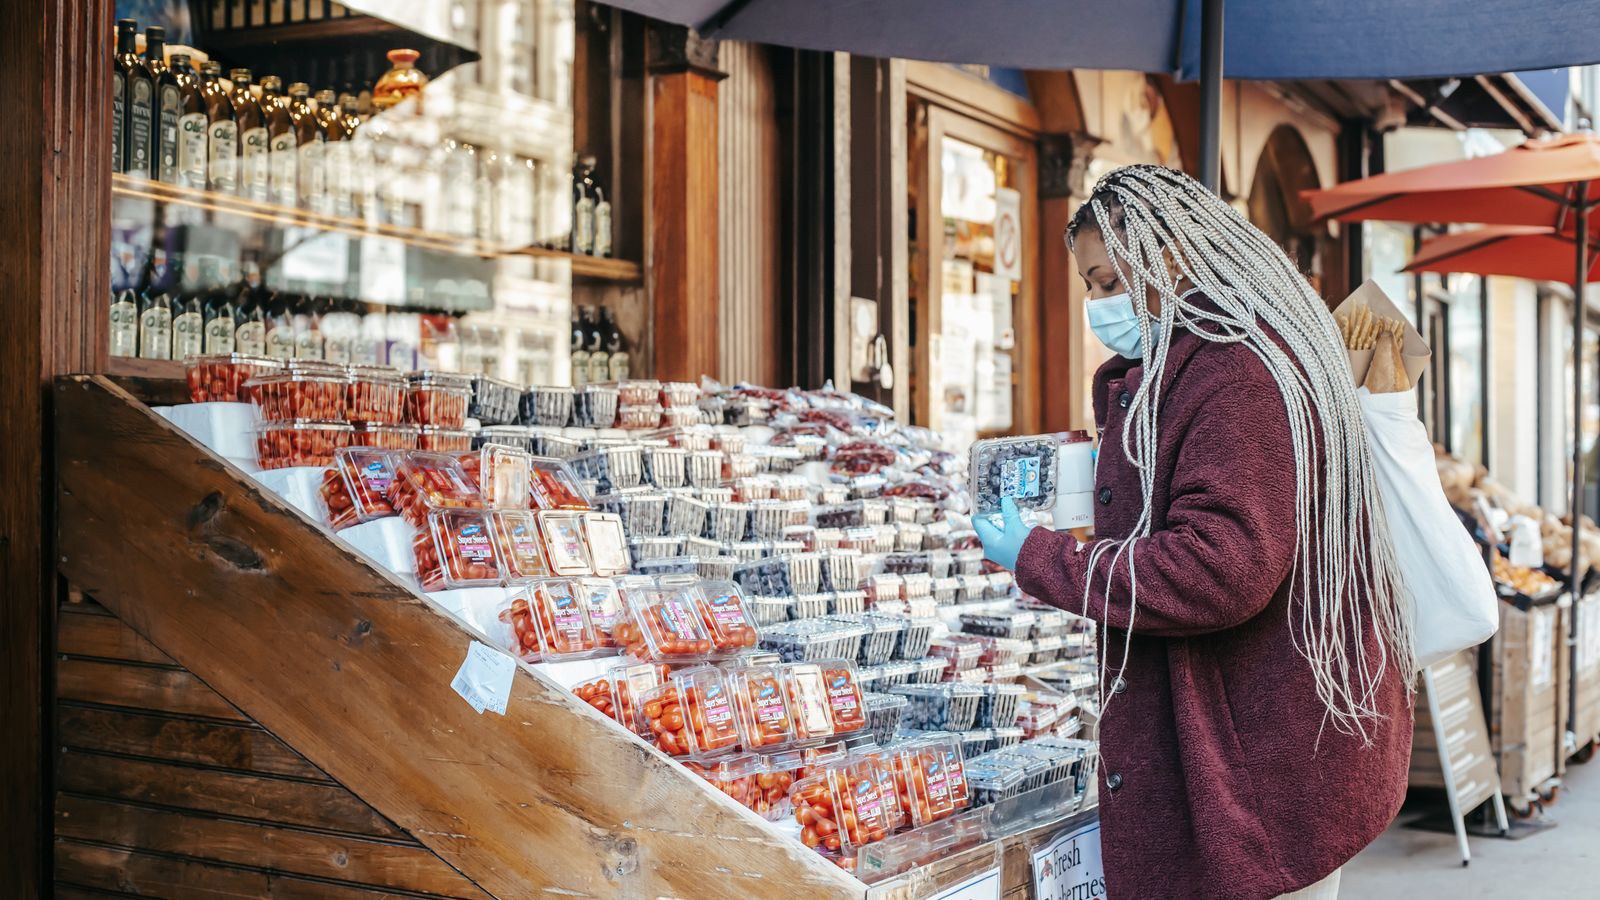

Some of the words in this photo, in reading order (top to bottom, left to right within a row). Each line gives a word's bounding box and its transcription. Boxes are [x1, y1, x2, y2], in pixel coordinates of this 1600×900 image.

[457, 535, 472, 546] Super
[472, 535, 488, 544] Sweet
[1053, 839, 1082, 880] Fresh
[1044, 871, 1106, 900] berries
